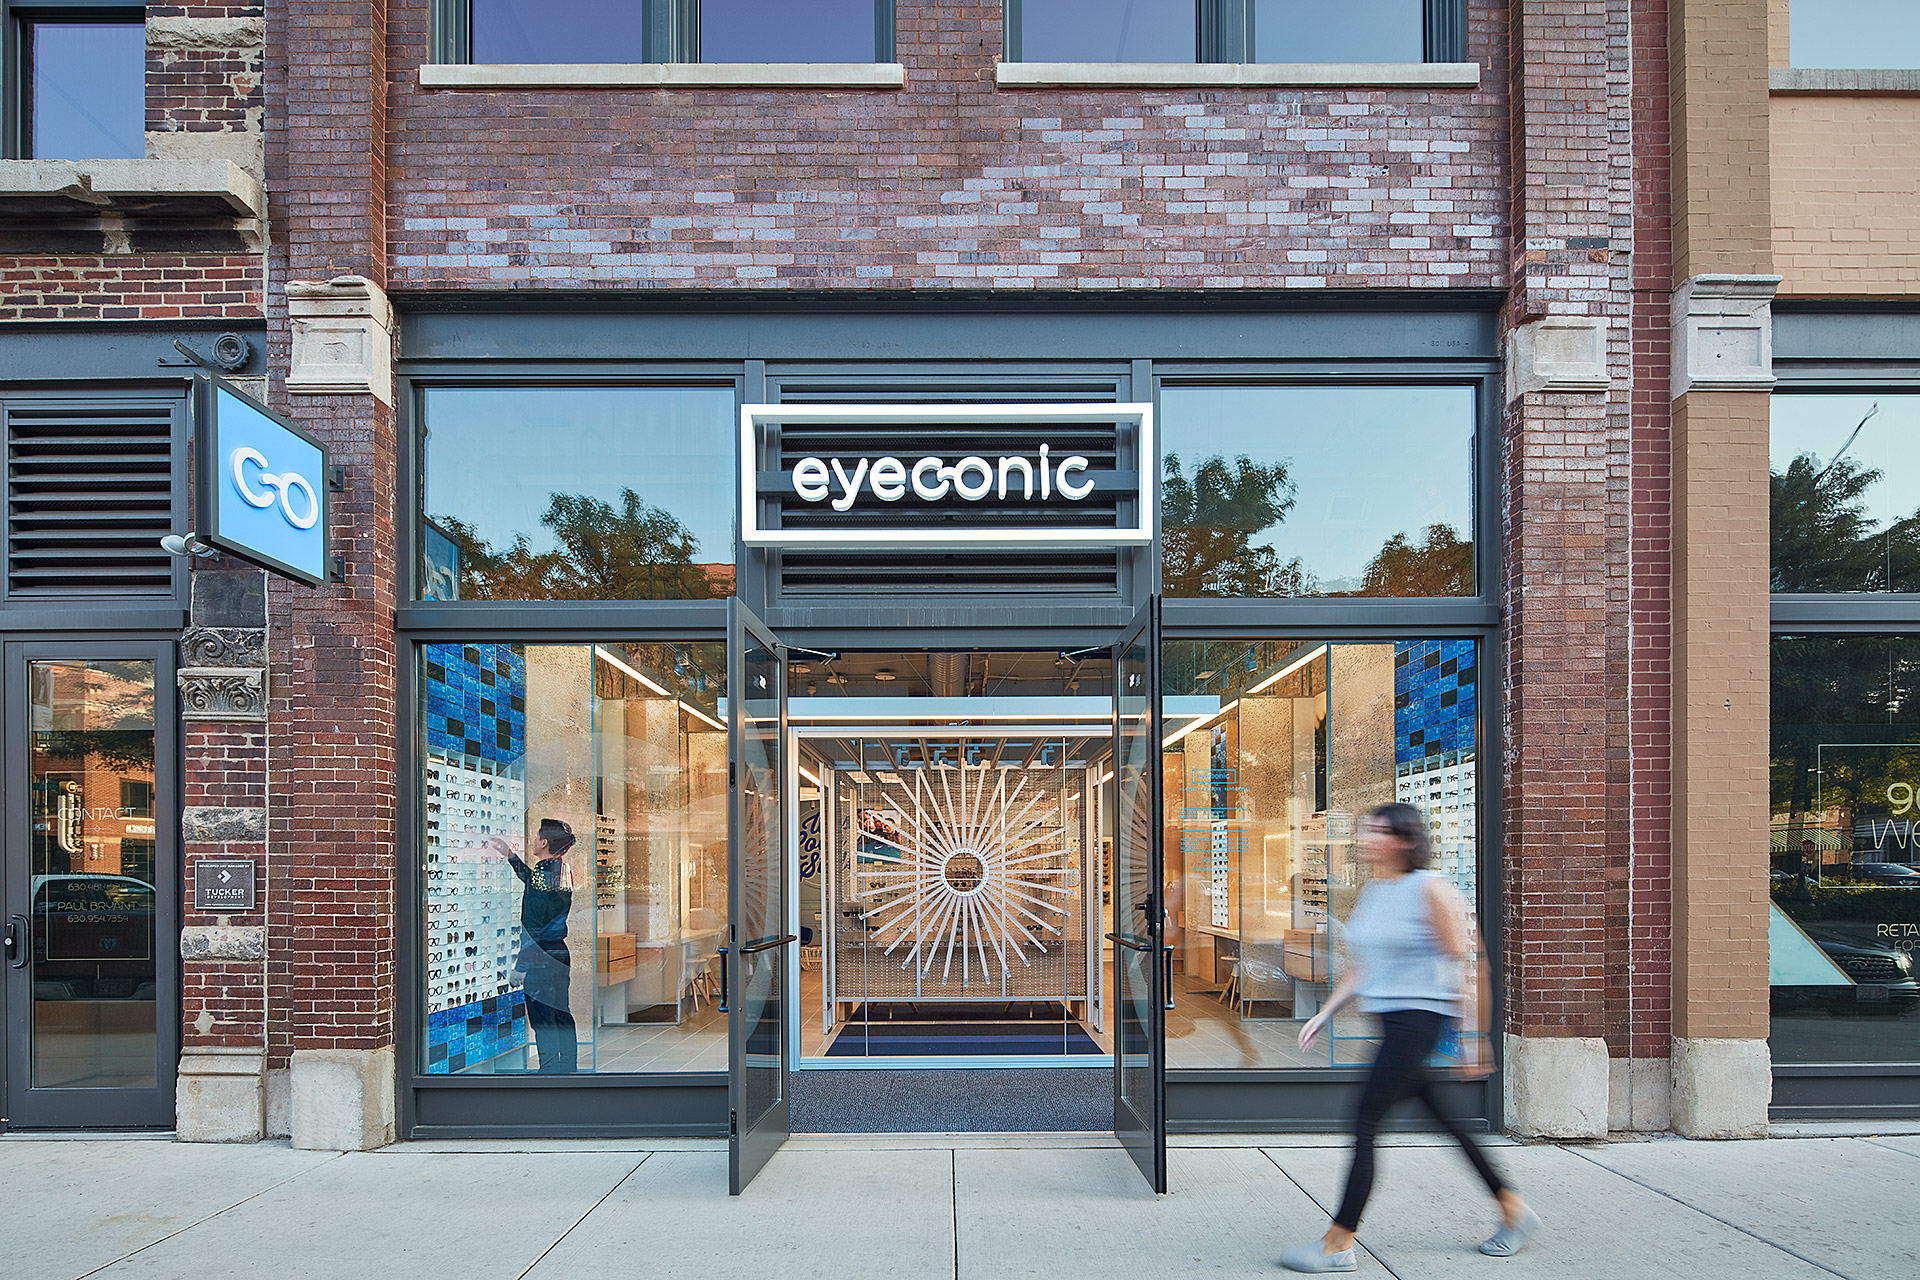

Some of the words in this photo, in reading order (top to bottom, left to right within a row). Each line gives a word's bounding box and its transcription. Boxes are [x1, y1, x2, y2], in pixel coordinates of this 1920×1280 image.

[791, 442, 1096, 512] eyeconic
[1197, 772, 1231, 781] eyeconic
[1887, 782, 1920, 815] 9
[57, 807, 137, 821] CONTACT
[57, 901, 87, 911] PAUL
[89, 901, 138, 911] BRYANT
